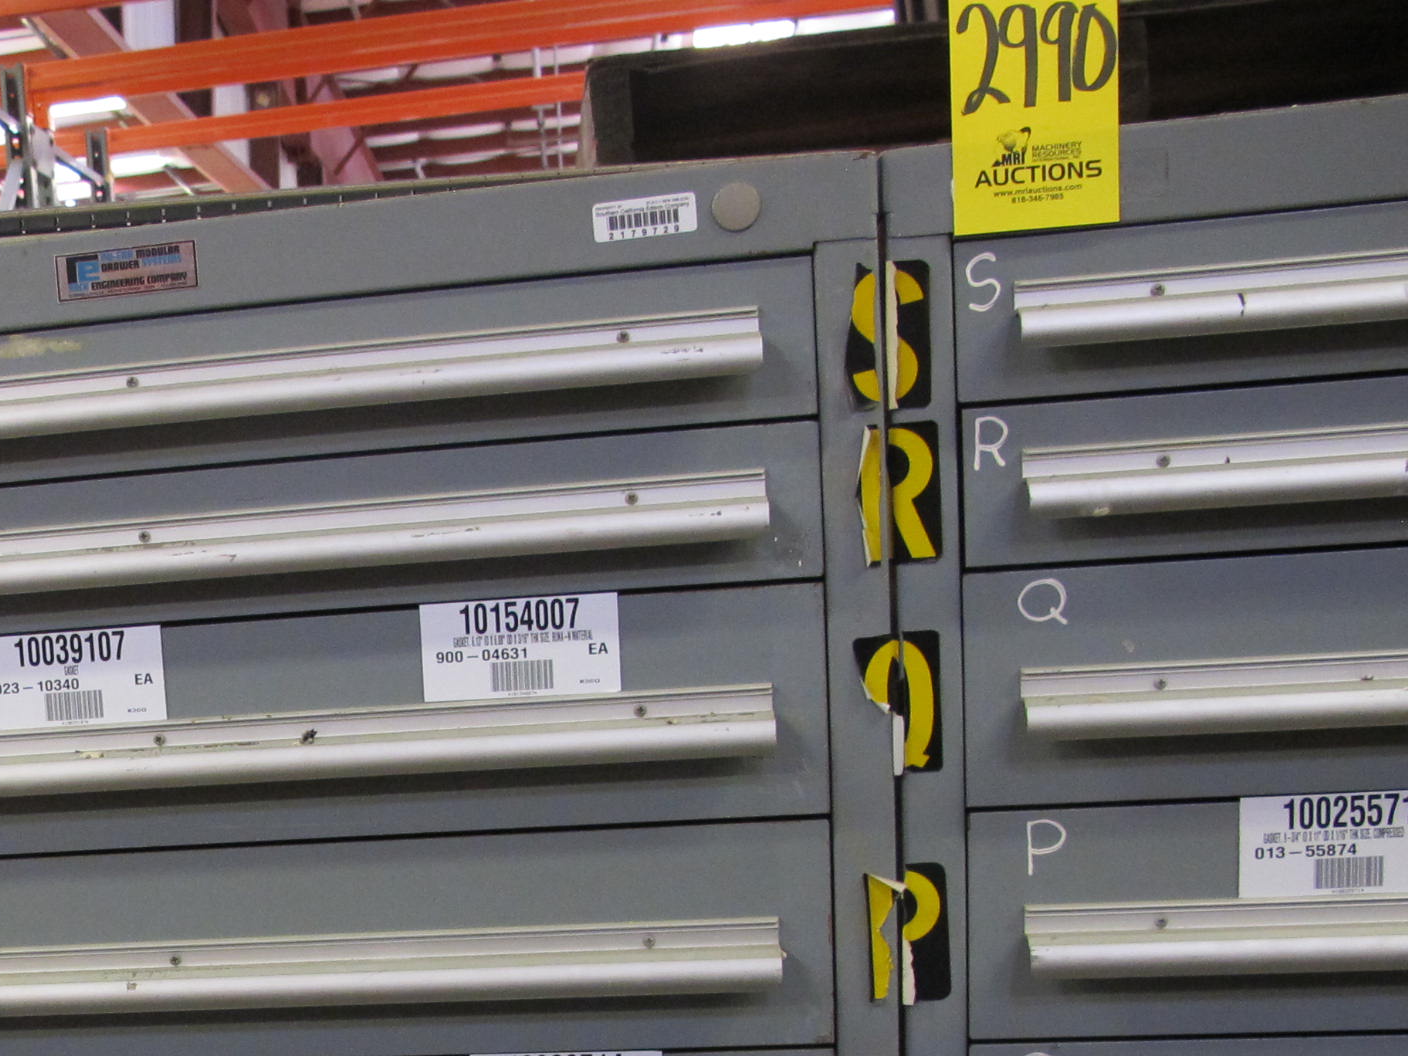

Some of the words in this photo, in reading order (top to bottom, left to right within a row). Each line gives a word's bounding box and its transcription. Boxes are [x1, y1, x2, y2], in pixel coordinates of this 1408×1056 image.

[956, 1, 1118, 116] 2990
[1032, 141, 1082, 152] MACHINERY
[975, 159, 1102, 189] AUCTIONS
[91, 276, 146, 291] ENGINEERING
[146, 271, 188, 286] COMPANY
[965, 252, 1001, 311] S
[974, 416, 1008, 470] R
[459, 597, 580, 635] 10154007
[1018, 578, 1067, 624] Q
[14, 630, 125, 667] 10039107
[588, 642, 608, 656] EA
[134, 673, 153, 686] EA
[1027, 819, 1067, 876] P
[1255, 843, 1357, 860] 013-55874
